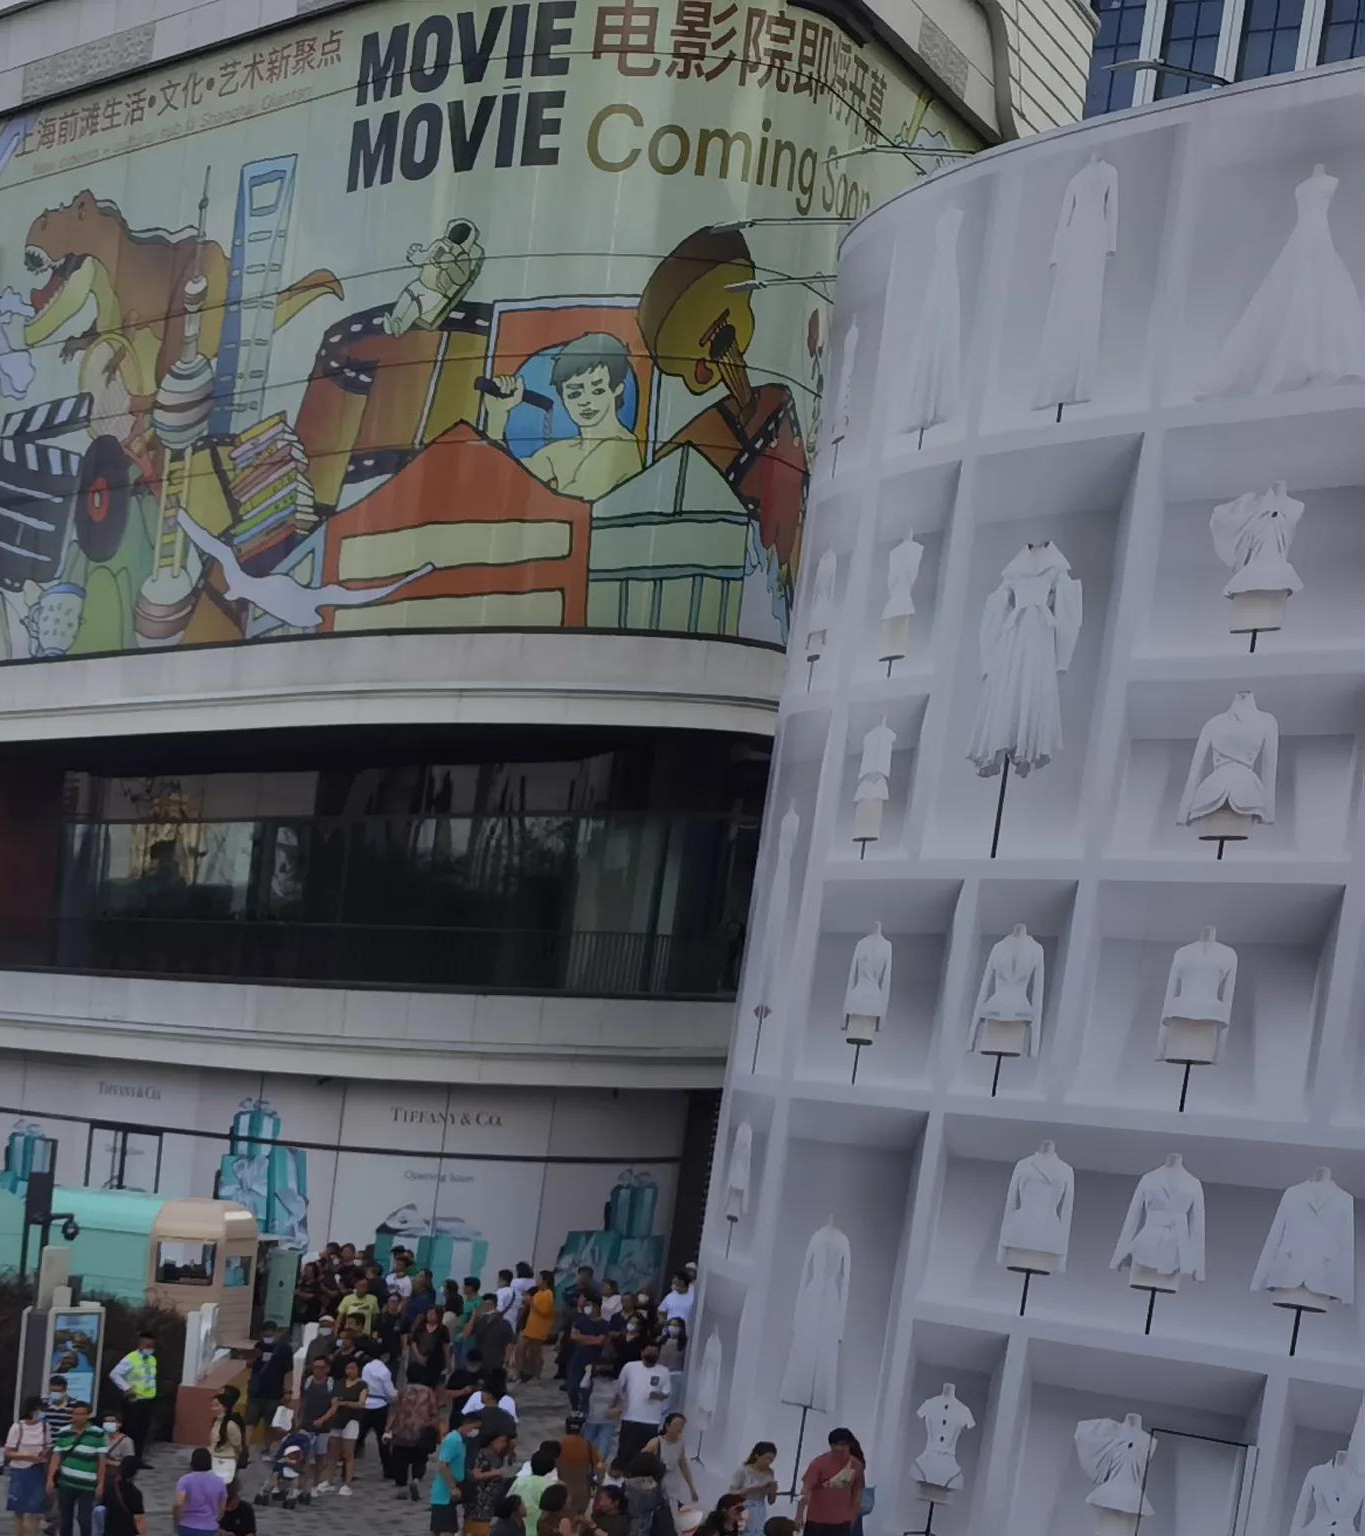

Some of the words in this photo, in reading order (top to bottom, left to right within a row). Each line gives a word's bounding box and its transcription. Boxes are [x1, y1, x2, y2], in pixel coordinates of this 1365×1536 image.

[355, 1, 576, 107] MOVIE
[346, 86, 566, 193] MOVIE
[587, 103, 818, 216] Coming
